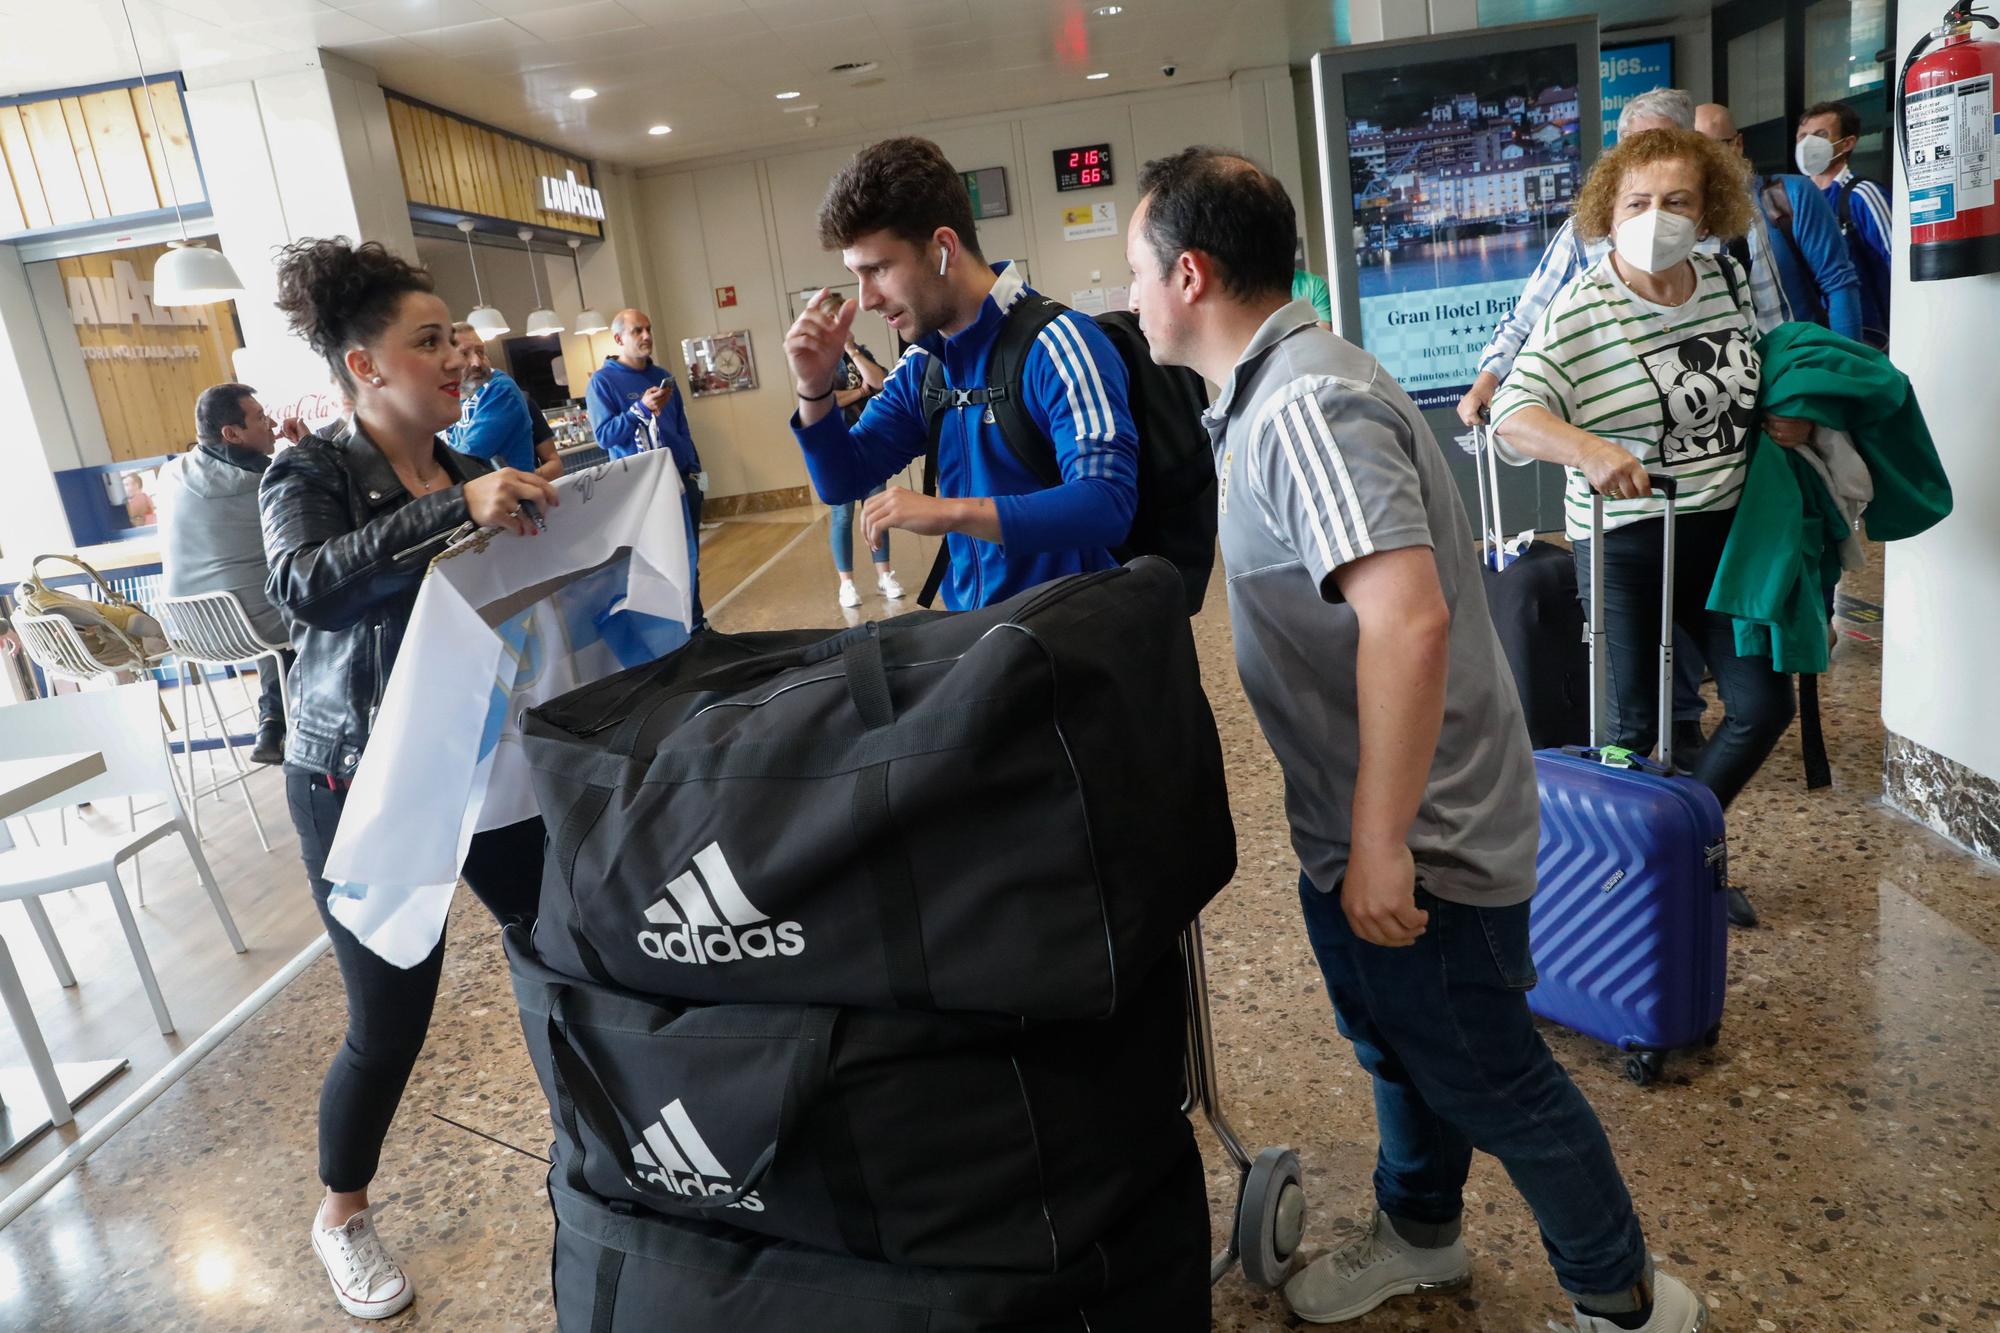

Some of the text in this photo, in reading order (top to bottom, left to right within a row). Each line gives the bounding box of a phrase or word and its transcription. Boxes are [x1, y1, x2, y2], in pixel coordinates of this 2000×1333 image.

[1081, 168, 1101, 184] 66
[542, 169, 606, 220] LAVAZZA
[1388, 310, 1431, 327] Gran
[1436, 300, 1481, 321] Hotel
[1423, 344, 1460, 359] HOTEL
[1410, 370, 1450, 383] minutos
[1453, 367, 1468, 378] del
[636, 920, 806, 965] adidas
